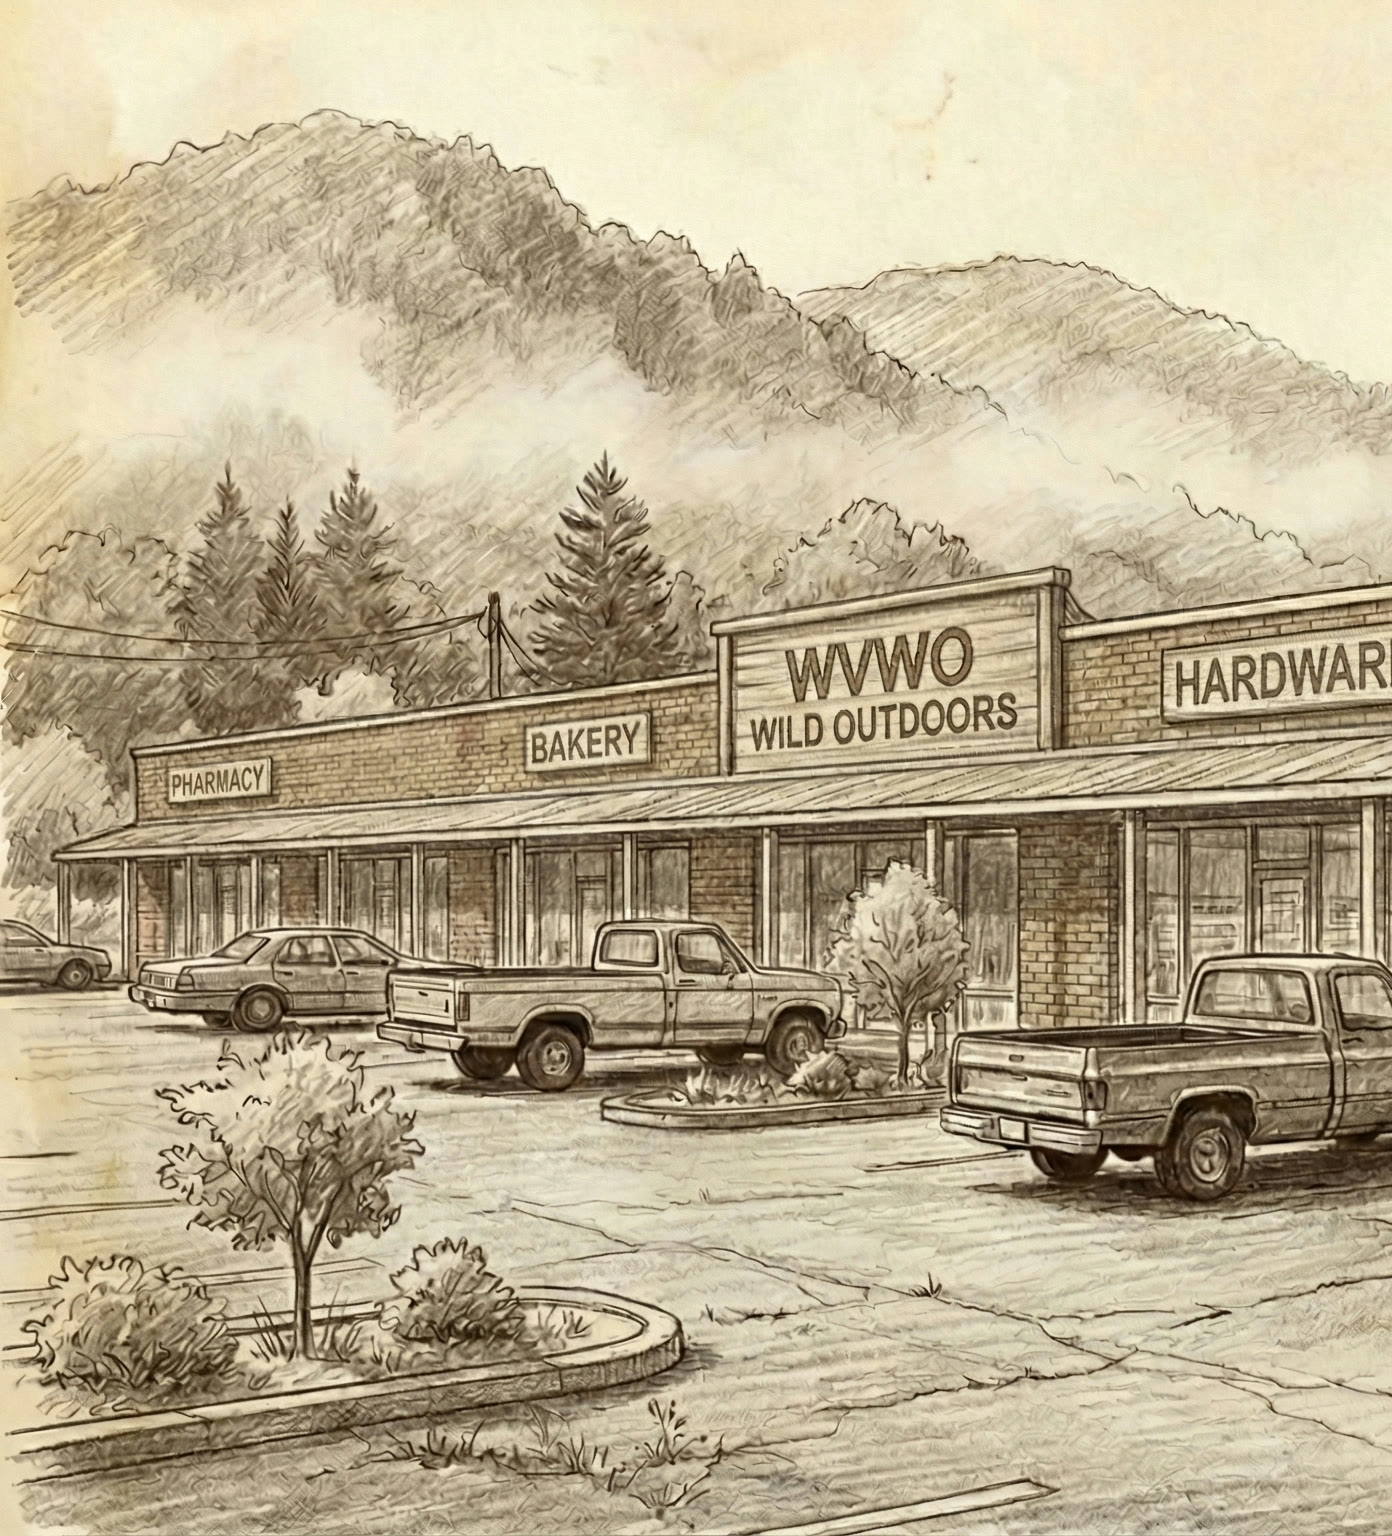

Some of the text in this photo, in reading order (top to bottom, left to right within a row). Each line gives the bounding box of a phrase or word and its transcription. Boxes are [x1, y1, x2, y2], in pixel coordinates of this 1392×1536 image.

[785, 627, 973, 702] WVWO
[532, 721, 640, 764] BAKERY
[751, 693, 1018, 751] WILD OUTDOORS
[172, 764, 264, 797] PHARMACY
